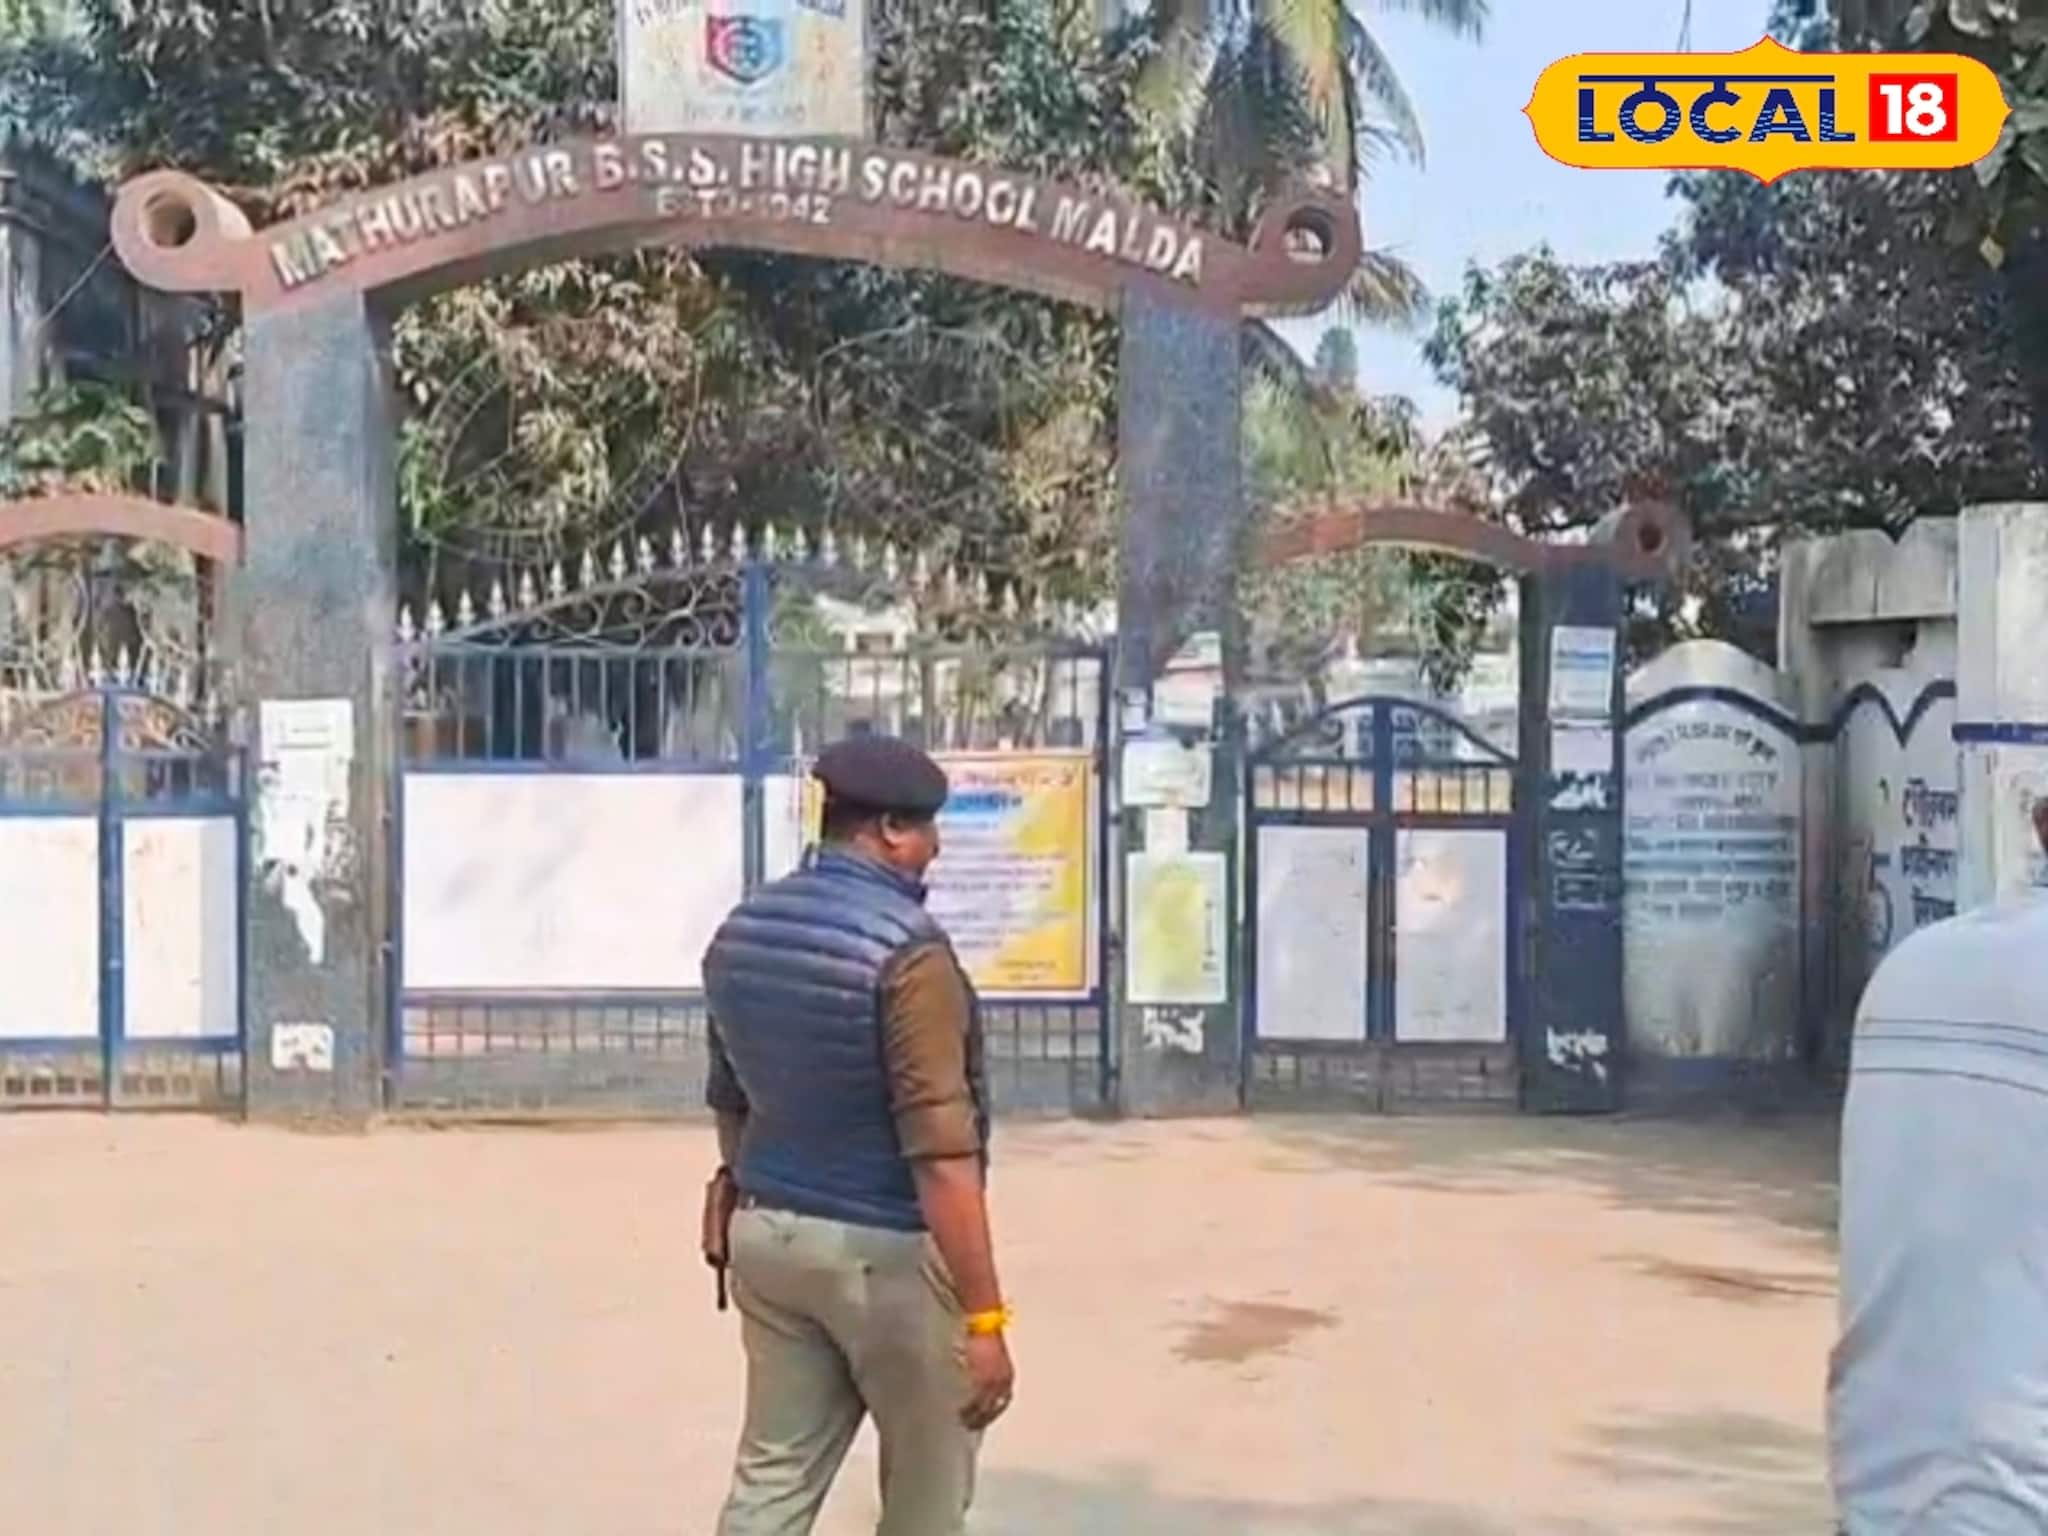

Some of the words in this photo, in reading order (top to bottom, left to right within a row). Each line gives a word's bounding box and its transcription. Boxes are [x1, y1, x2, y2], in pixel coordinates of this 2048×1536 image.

[270, 148, 580, 288] MATHURAPUR
[594, 139, 729, 189] B.S.S.
[740, 142, 851, 196] HIGH
[861, 150, 1038, 229] SCHOOL
[1050, 196, 1204, 284] MALDA
